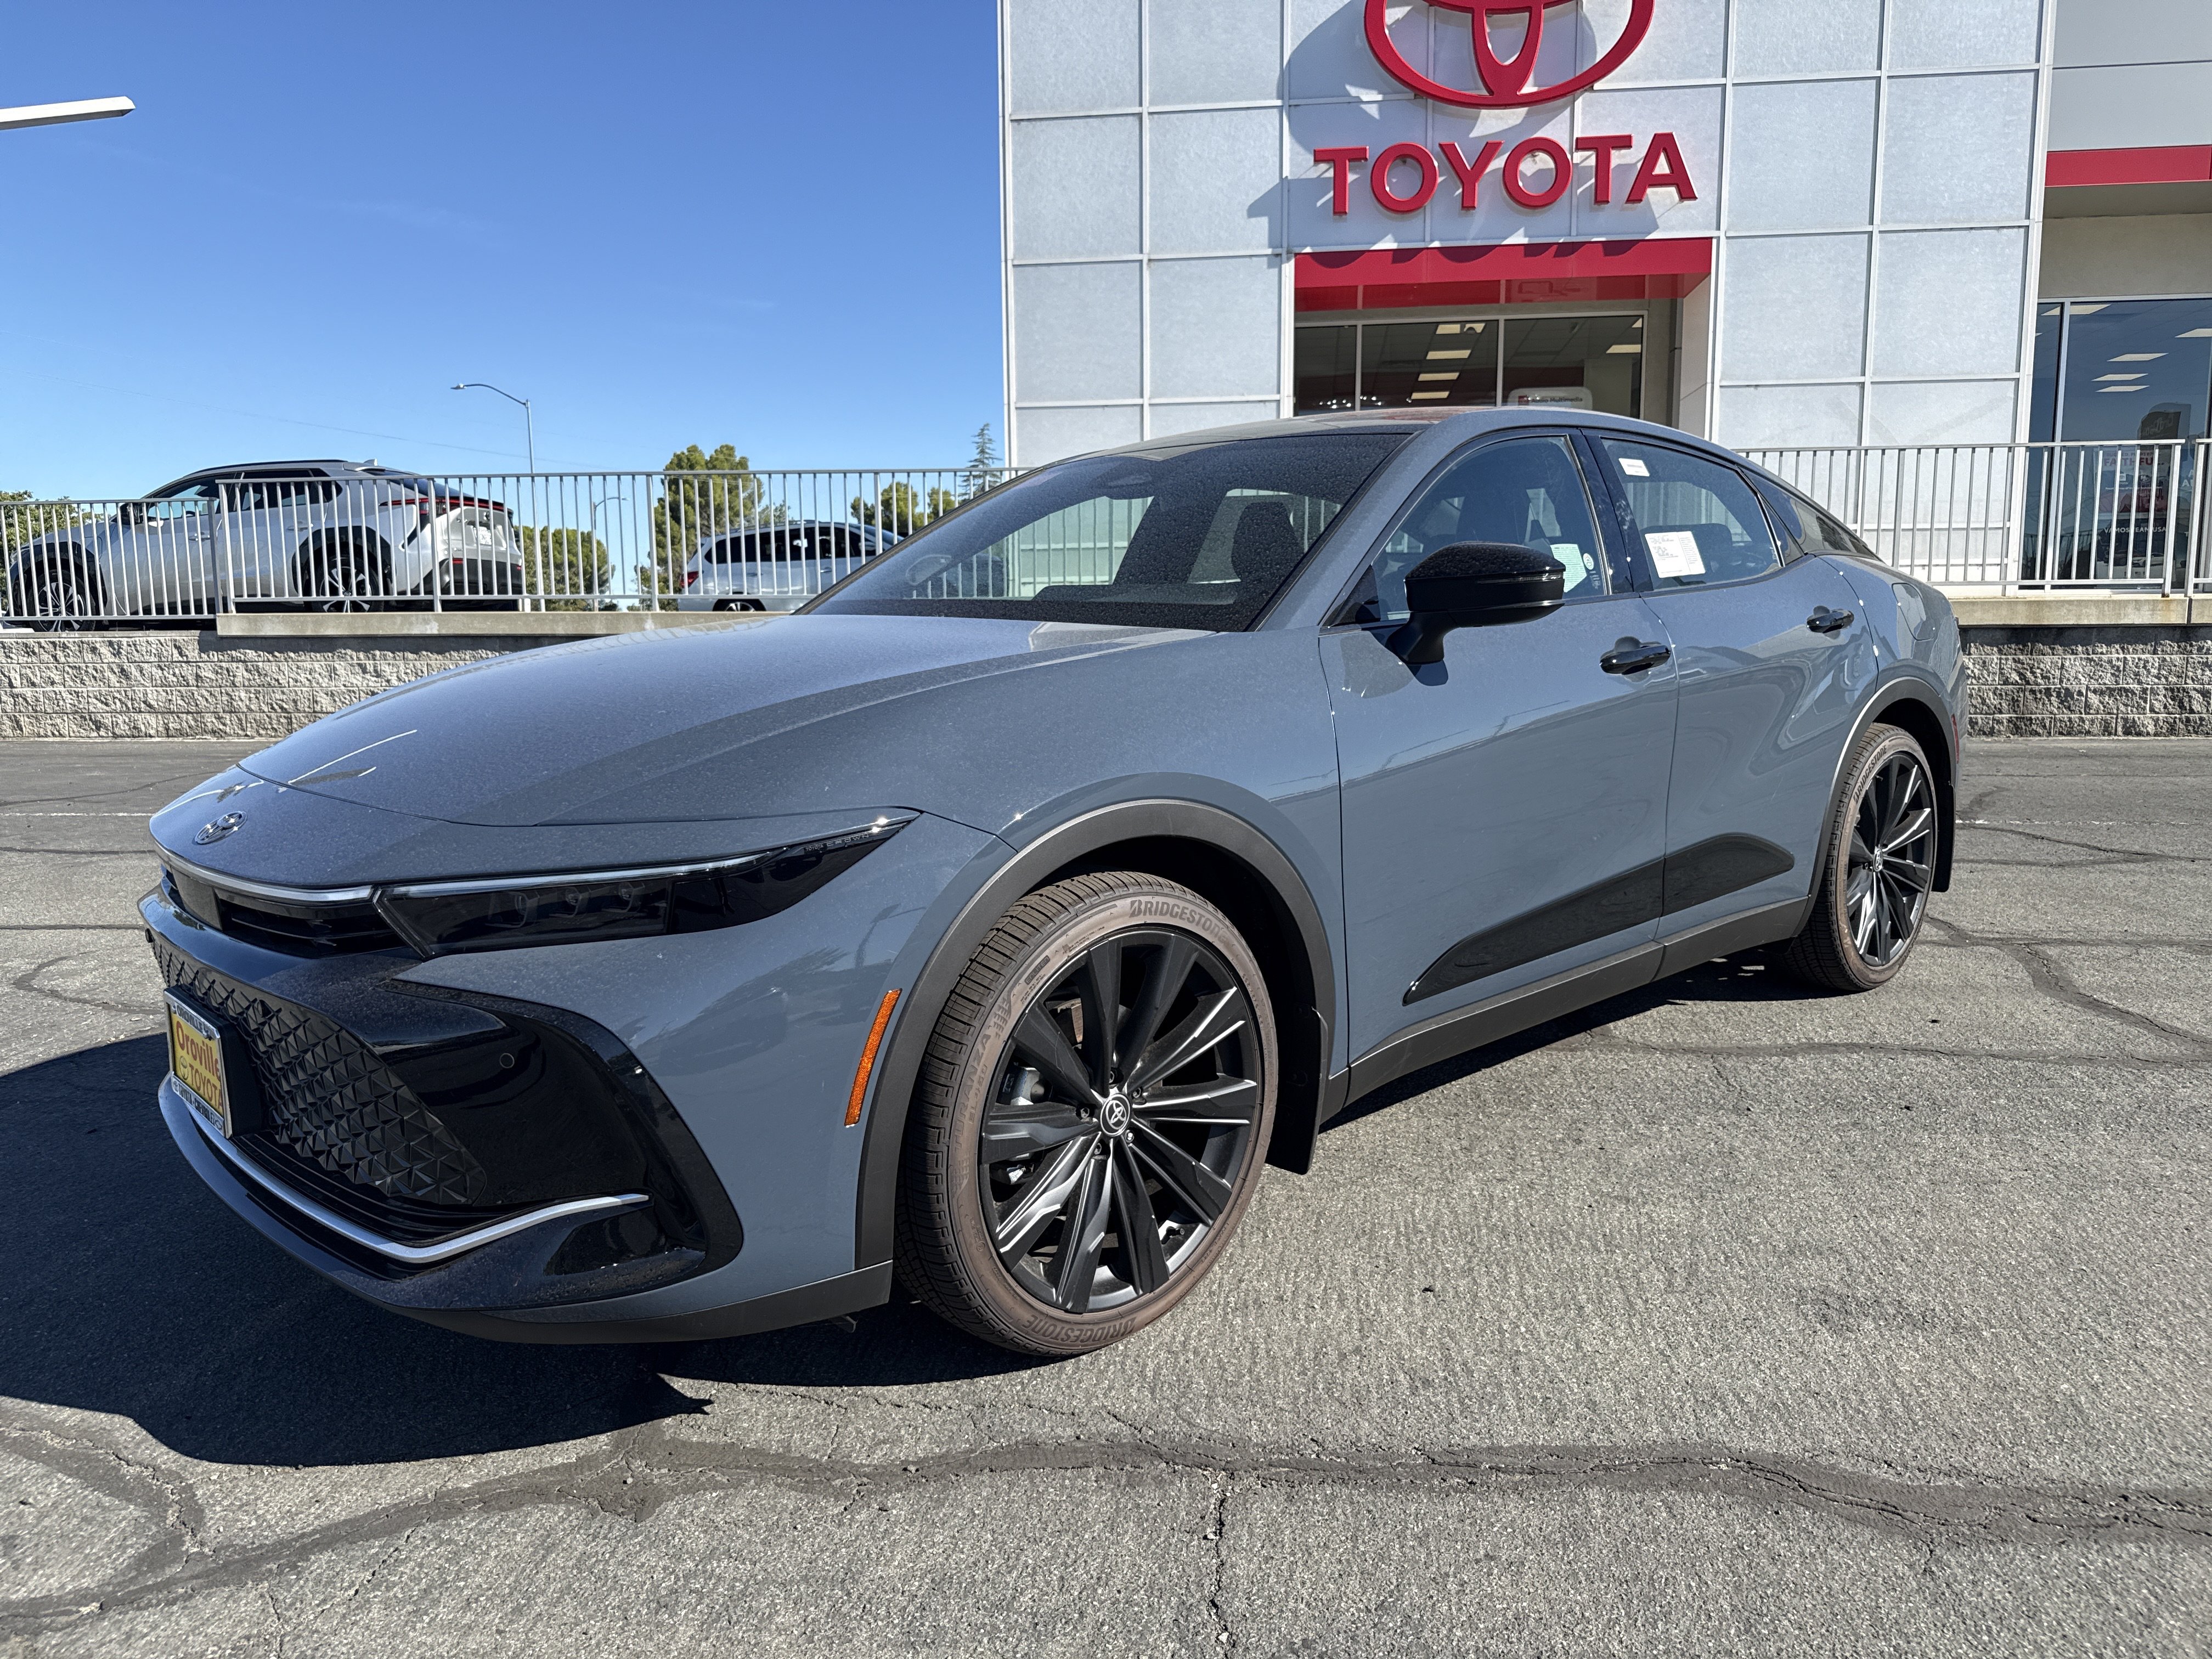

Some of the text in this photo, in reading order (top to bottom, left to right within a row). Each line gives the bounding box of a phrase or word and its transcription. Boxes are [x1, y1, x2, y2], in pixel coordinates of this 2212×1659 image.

[1313, 132, 1698, 216] TOYOTA
[1853, 745, 1887, 804] BRIDGESTONE
[827, 834, 870, 847] CROWN
[1129, 899, 1229, 944] BRIDGESTONE
[1026, 957, 1049, 984] ENLITEN
[176, 1020, 221, 1081] Oroville
[189, 1063, 223, 1108] TOYOTA
[955, 1034, 990, 1152] TURANZA
[1022, 1314, 1137, 1344] BRIDGESTONE
